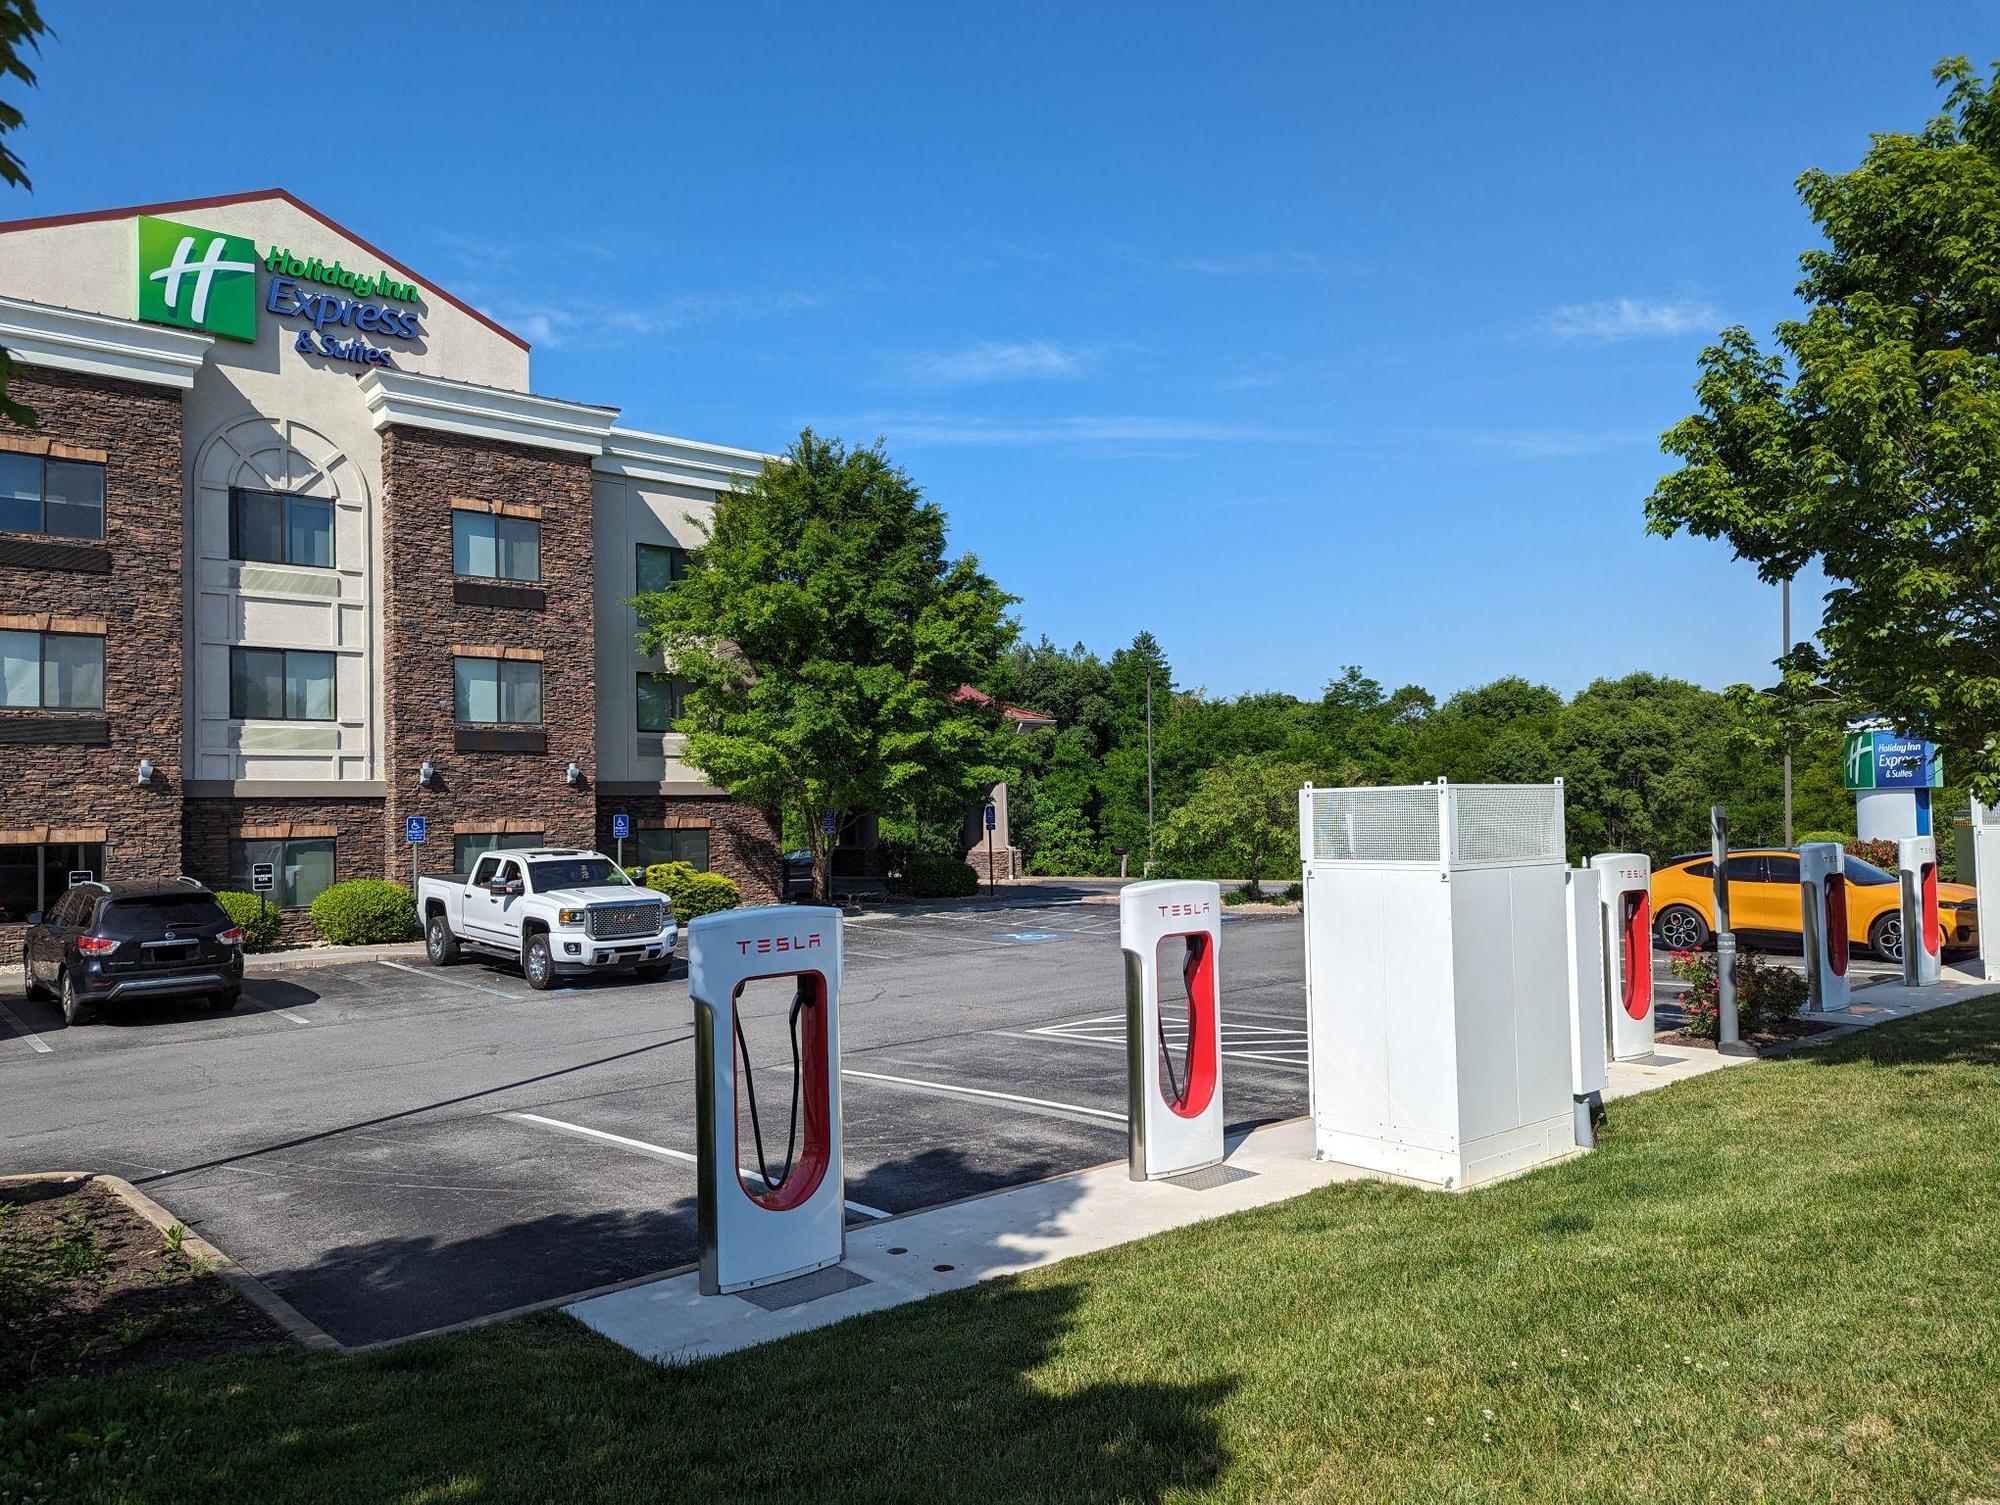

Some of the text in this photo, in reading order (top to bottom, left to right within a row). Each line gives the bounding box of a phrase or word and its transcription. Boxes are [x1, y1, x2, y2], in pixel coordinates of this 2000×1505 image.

[264, 246, 417, 303] Holiday Inn
[266, 276, 420, 340] Express
[294, 329, 392, 367] & Suites
[1878, 742, 1921, 753] Holiday Inn
[1891, 770, 1913, 778] Suites
[1158, 902, 1210, 917] TESLA
[736, 933, 821, 955] TESLA
